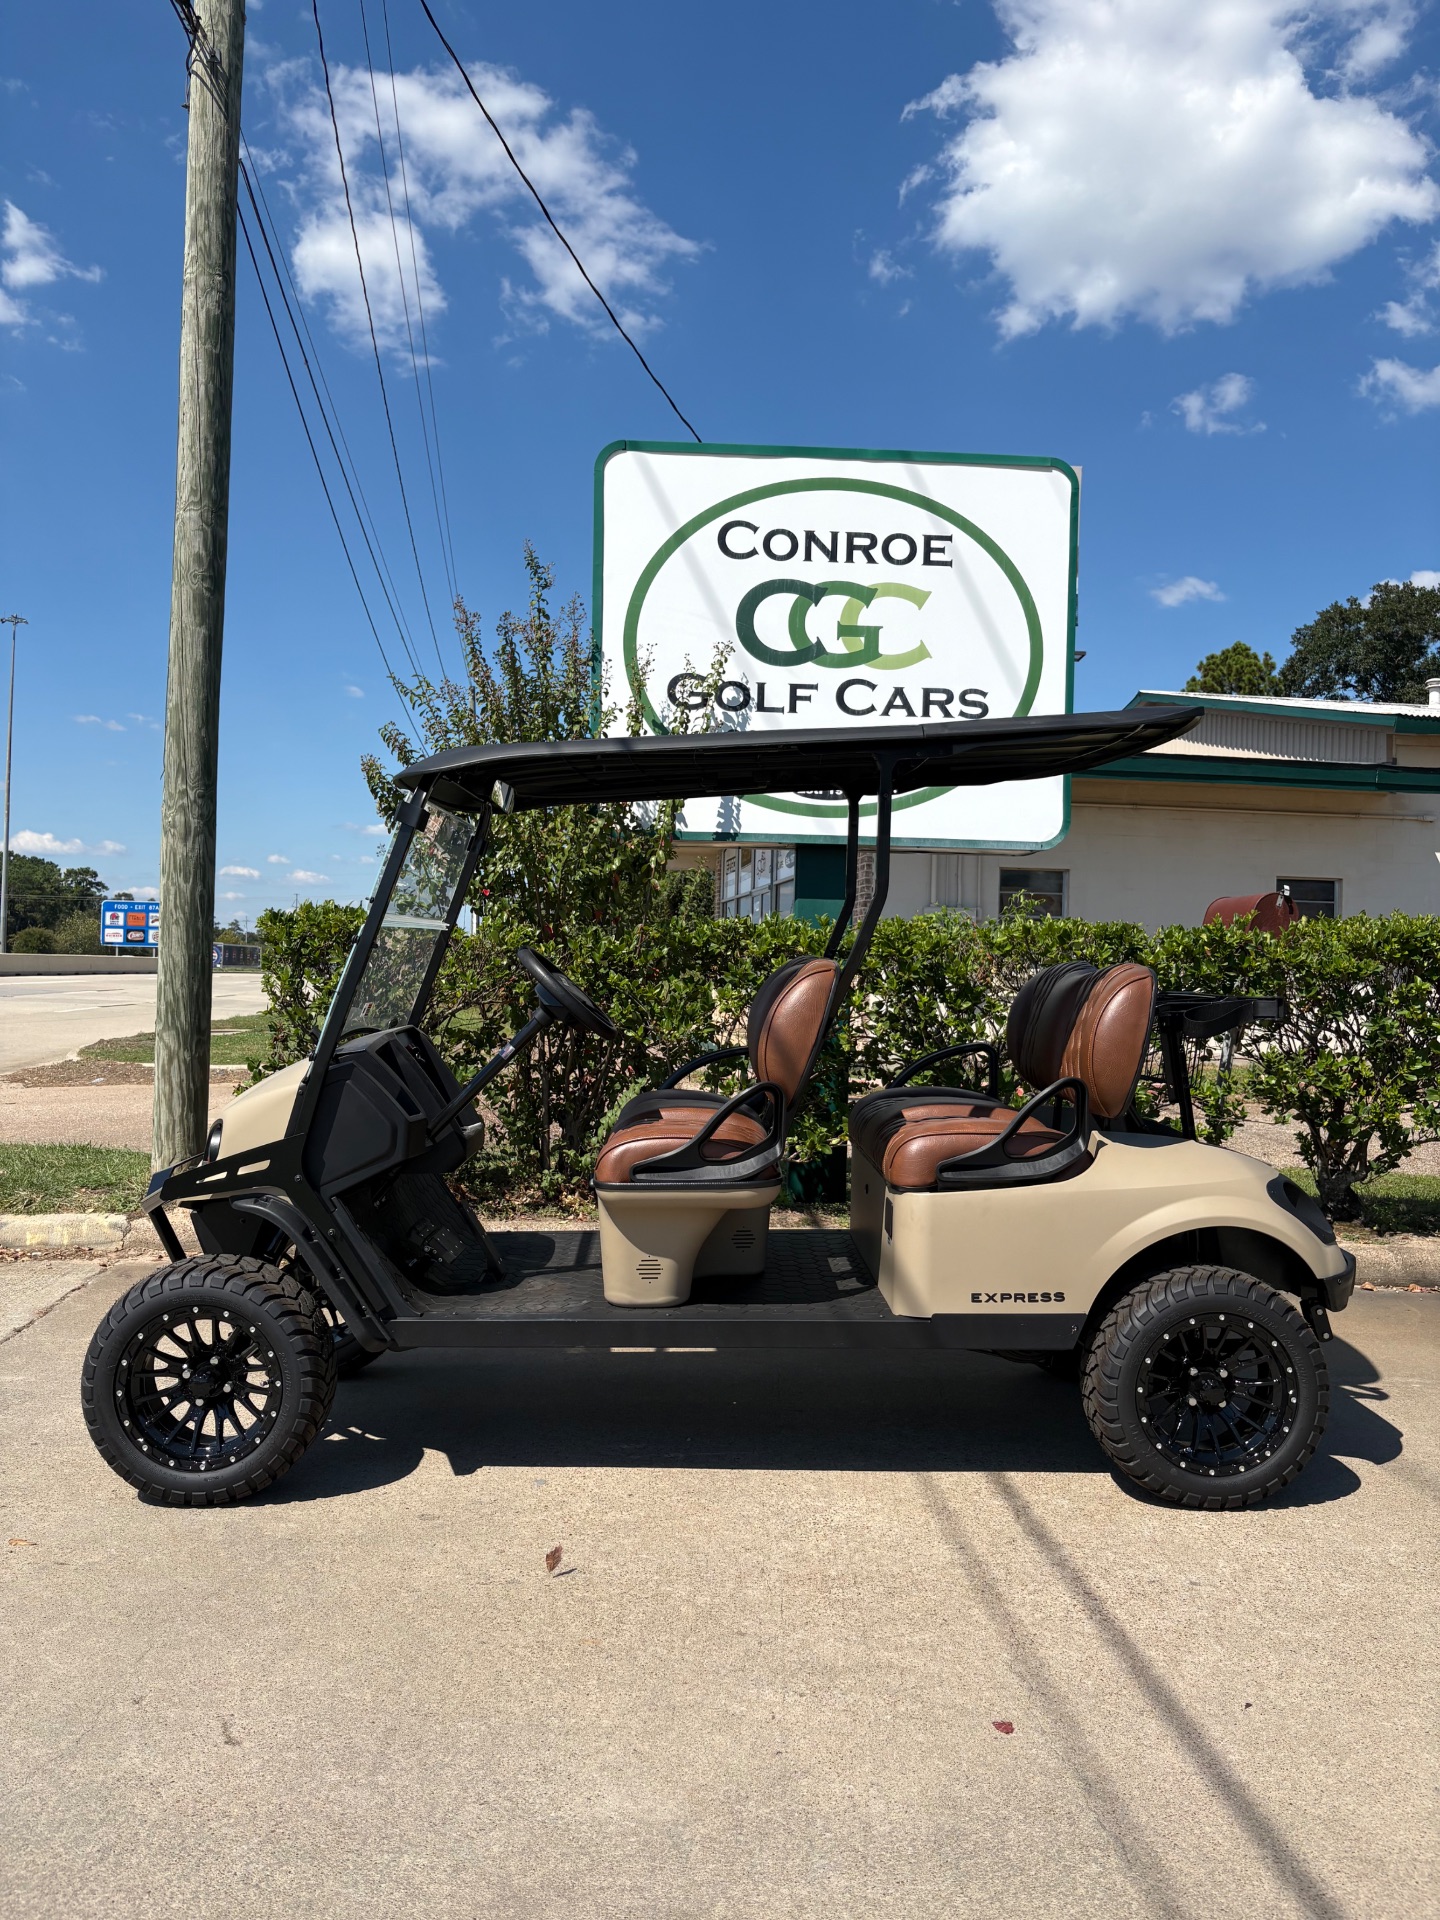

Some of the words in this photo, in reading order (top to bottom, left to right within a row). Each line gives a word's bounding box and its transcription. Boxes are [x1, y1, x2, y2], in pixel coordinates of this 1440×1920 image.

[717, 519, 953, 568] CONROE
[735, 578, 932, 670] CGC
[667, 672, 819, 715] GOLF
[835, 678, 989, 719] CARS
[970, 1292, 1065, 1303] EXPRESS
